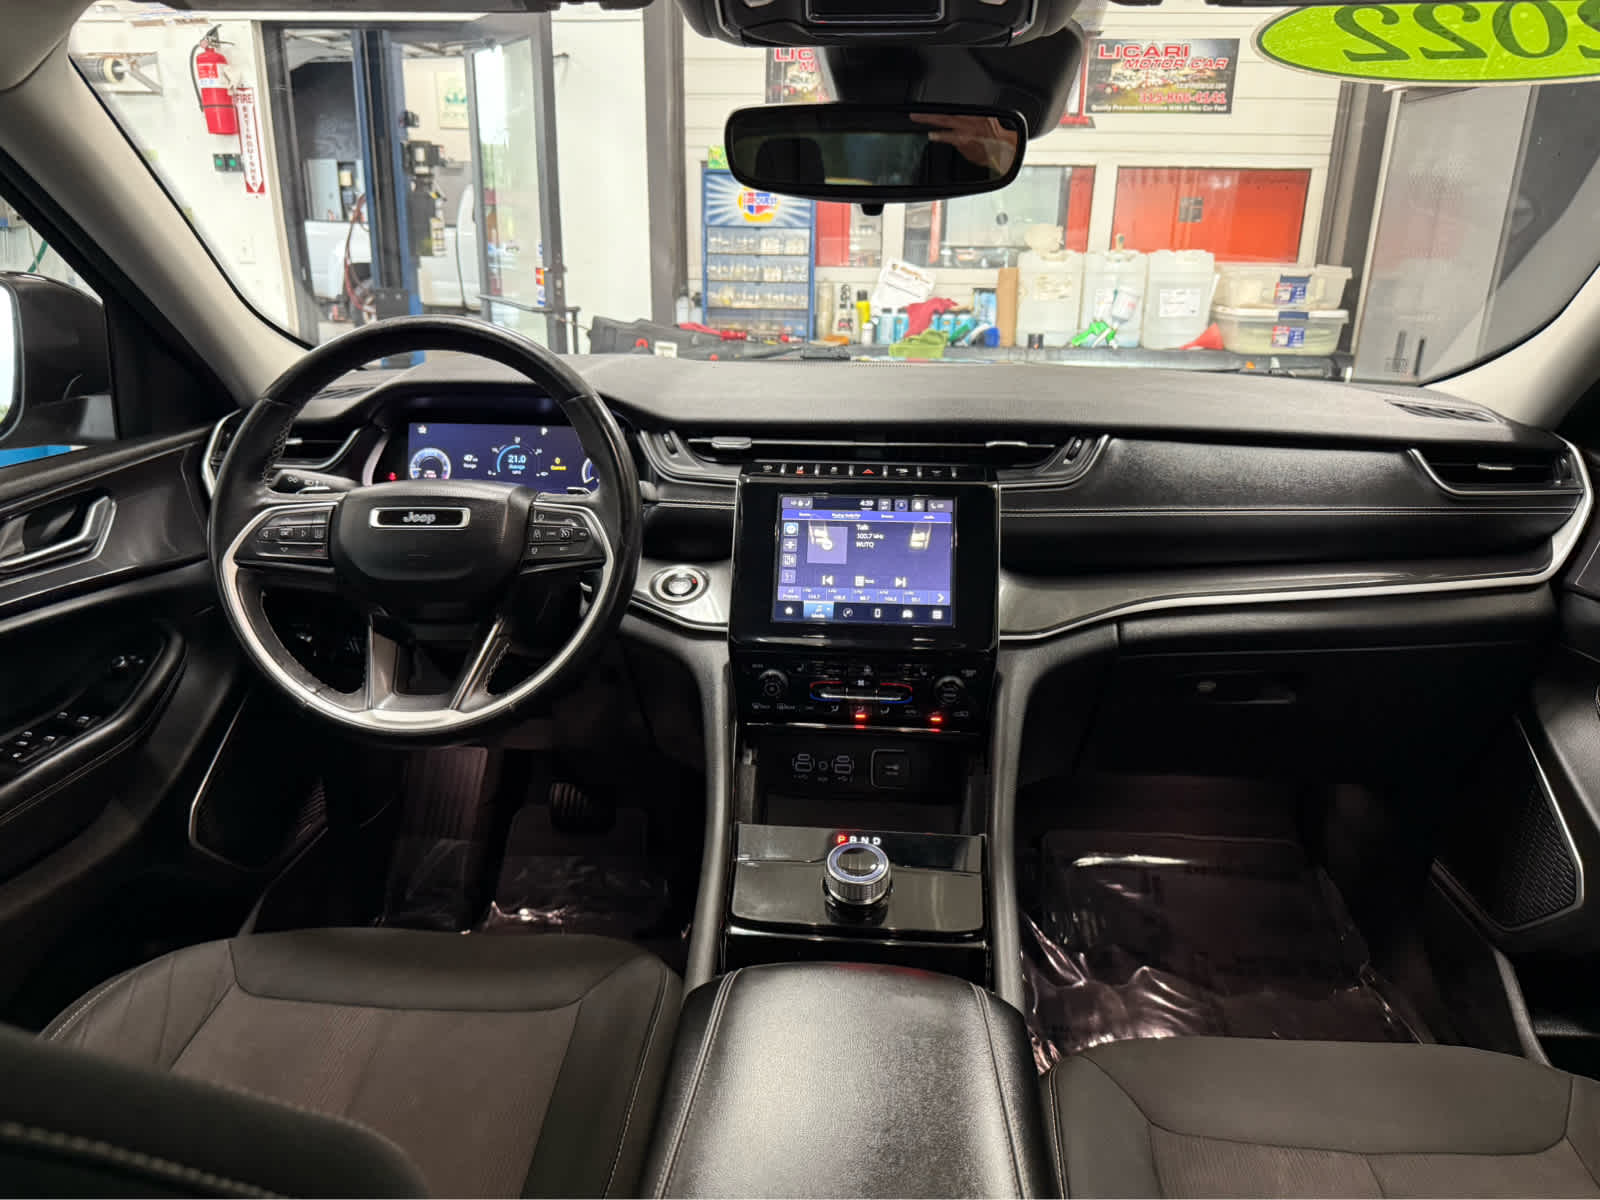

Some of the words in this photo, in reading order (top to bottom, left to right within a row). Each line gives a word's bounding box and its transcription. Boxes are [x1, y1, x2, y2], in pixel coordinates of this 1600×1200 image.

[1098, 44, 1190, 59] LICARI
[1123, 59, 1185, 70] MOTOR
[1190, 58, 1228, 70] CAR
[235, 94, 253, 103] FIRE
[507, 455, 527, 463] 21.0
[403, 511, 436, 524] Jeep
[837, 834, 846, 844] P
[861, 836, 869, 844] N
[872, 837, 881, 846] D
